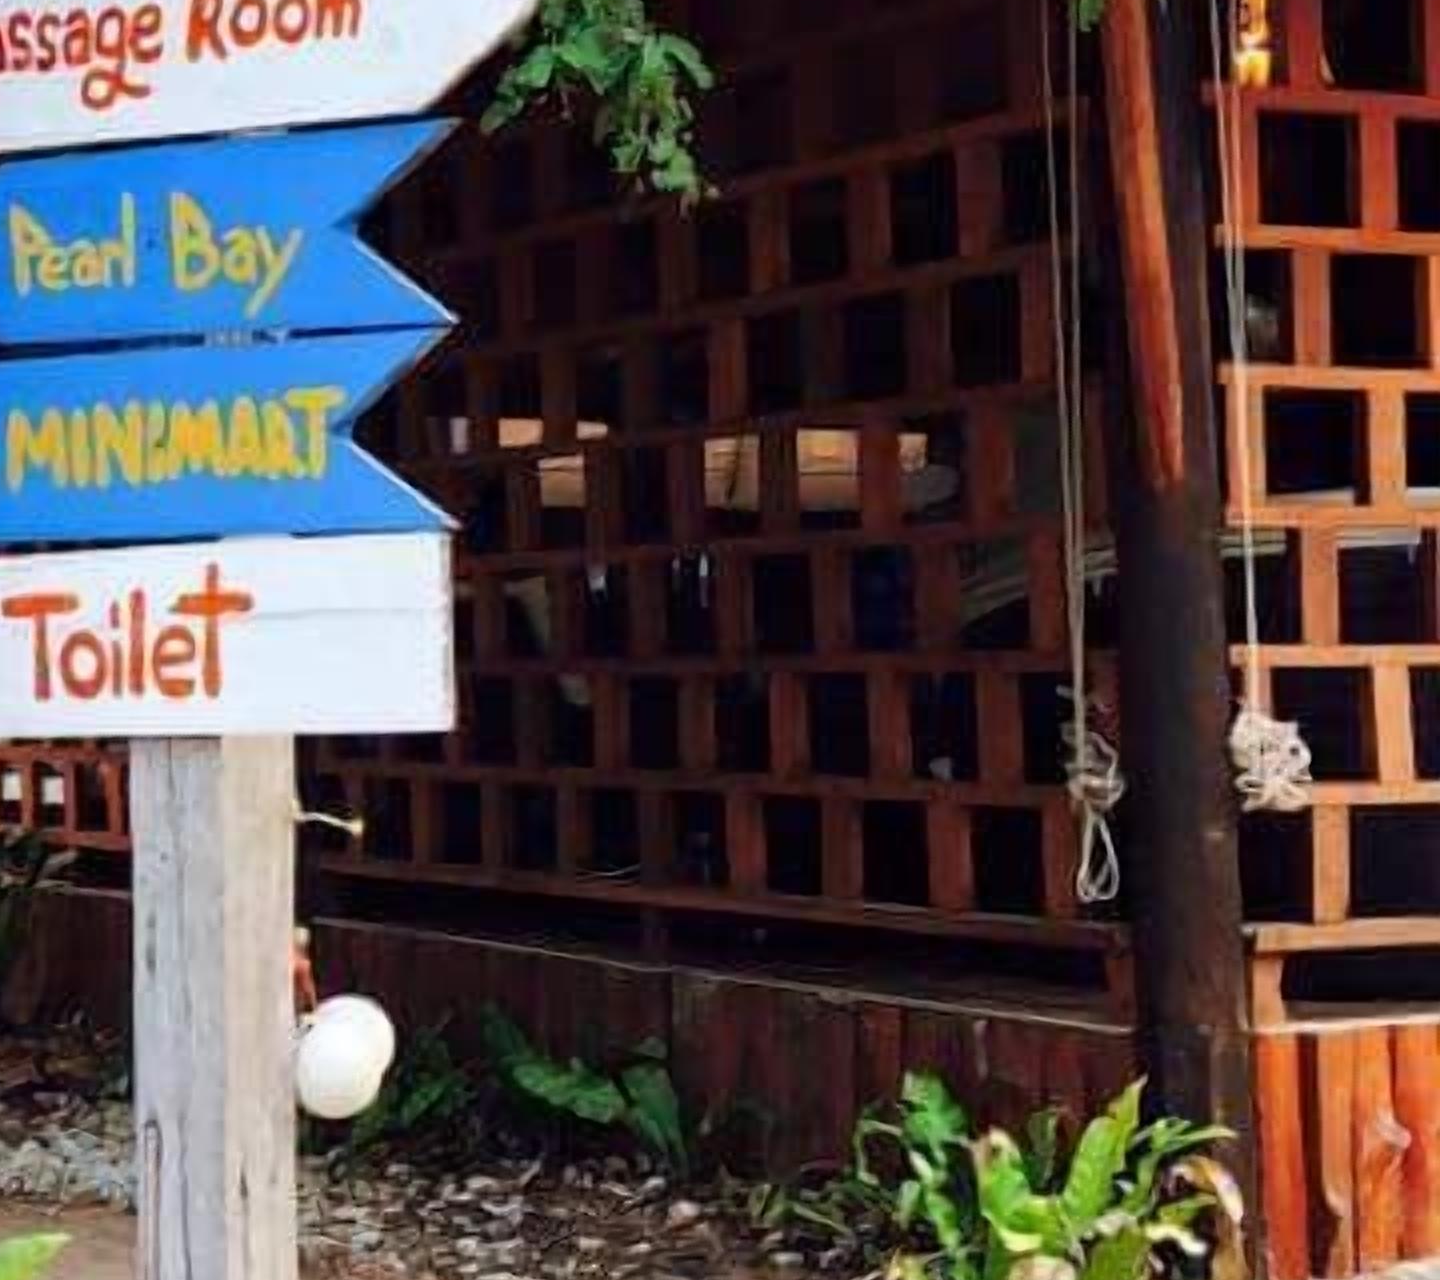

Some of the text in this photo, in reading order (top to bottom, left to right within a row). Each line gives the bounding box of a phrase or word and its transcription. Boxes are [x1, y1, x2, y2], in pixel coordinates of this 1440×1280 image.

[9, 191, 303, 318] Pearl Bay
[1, 562, 254, 701] Toilet
